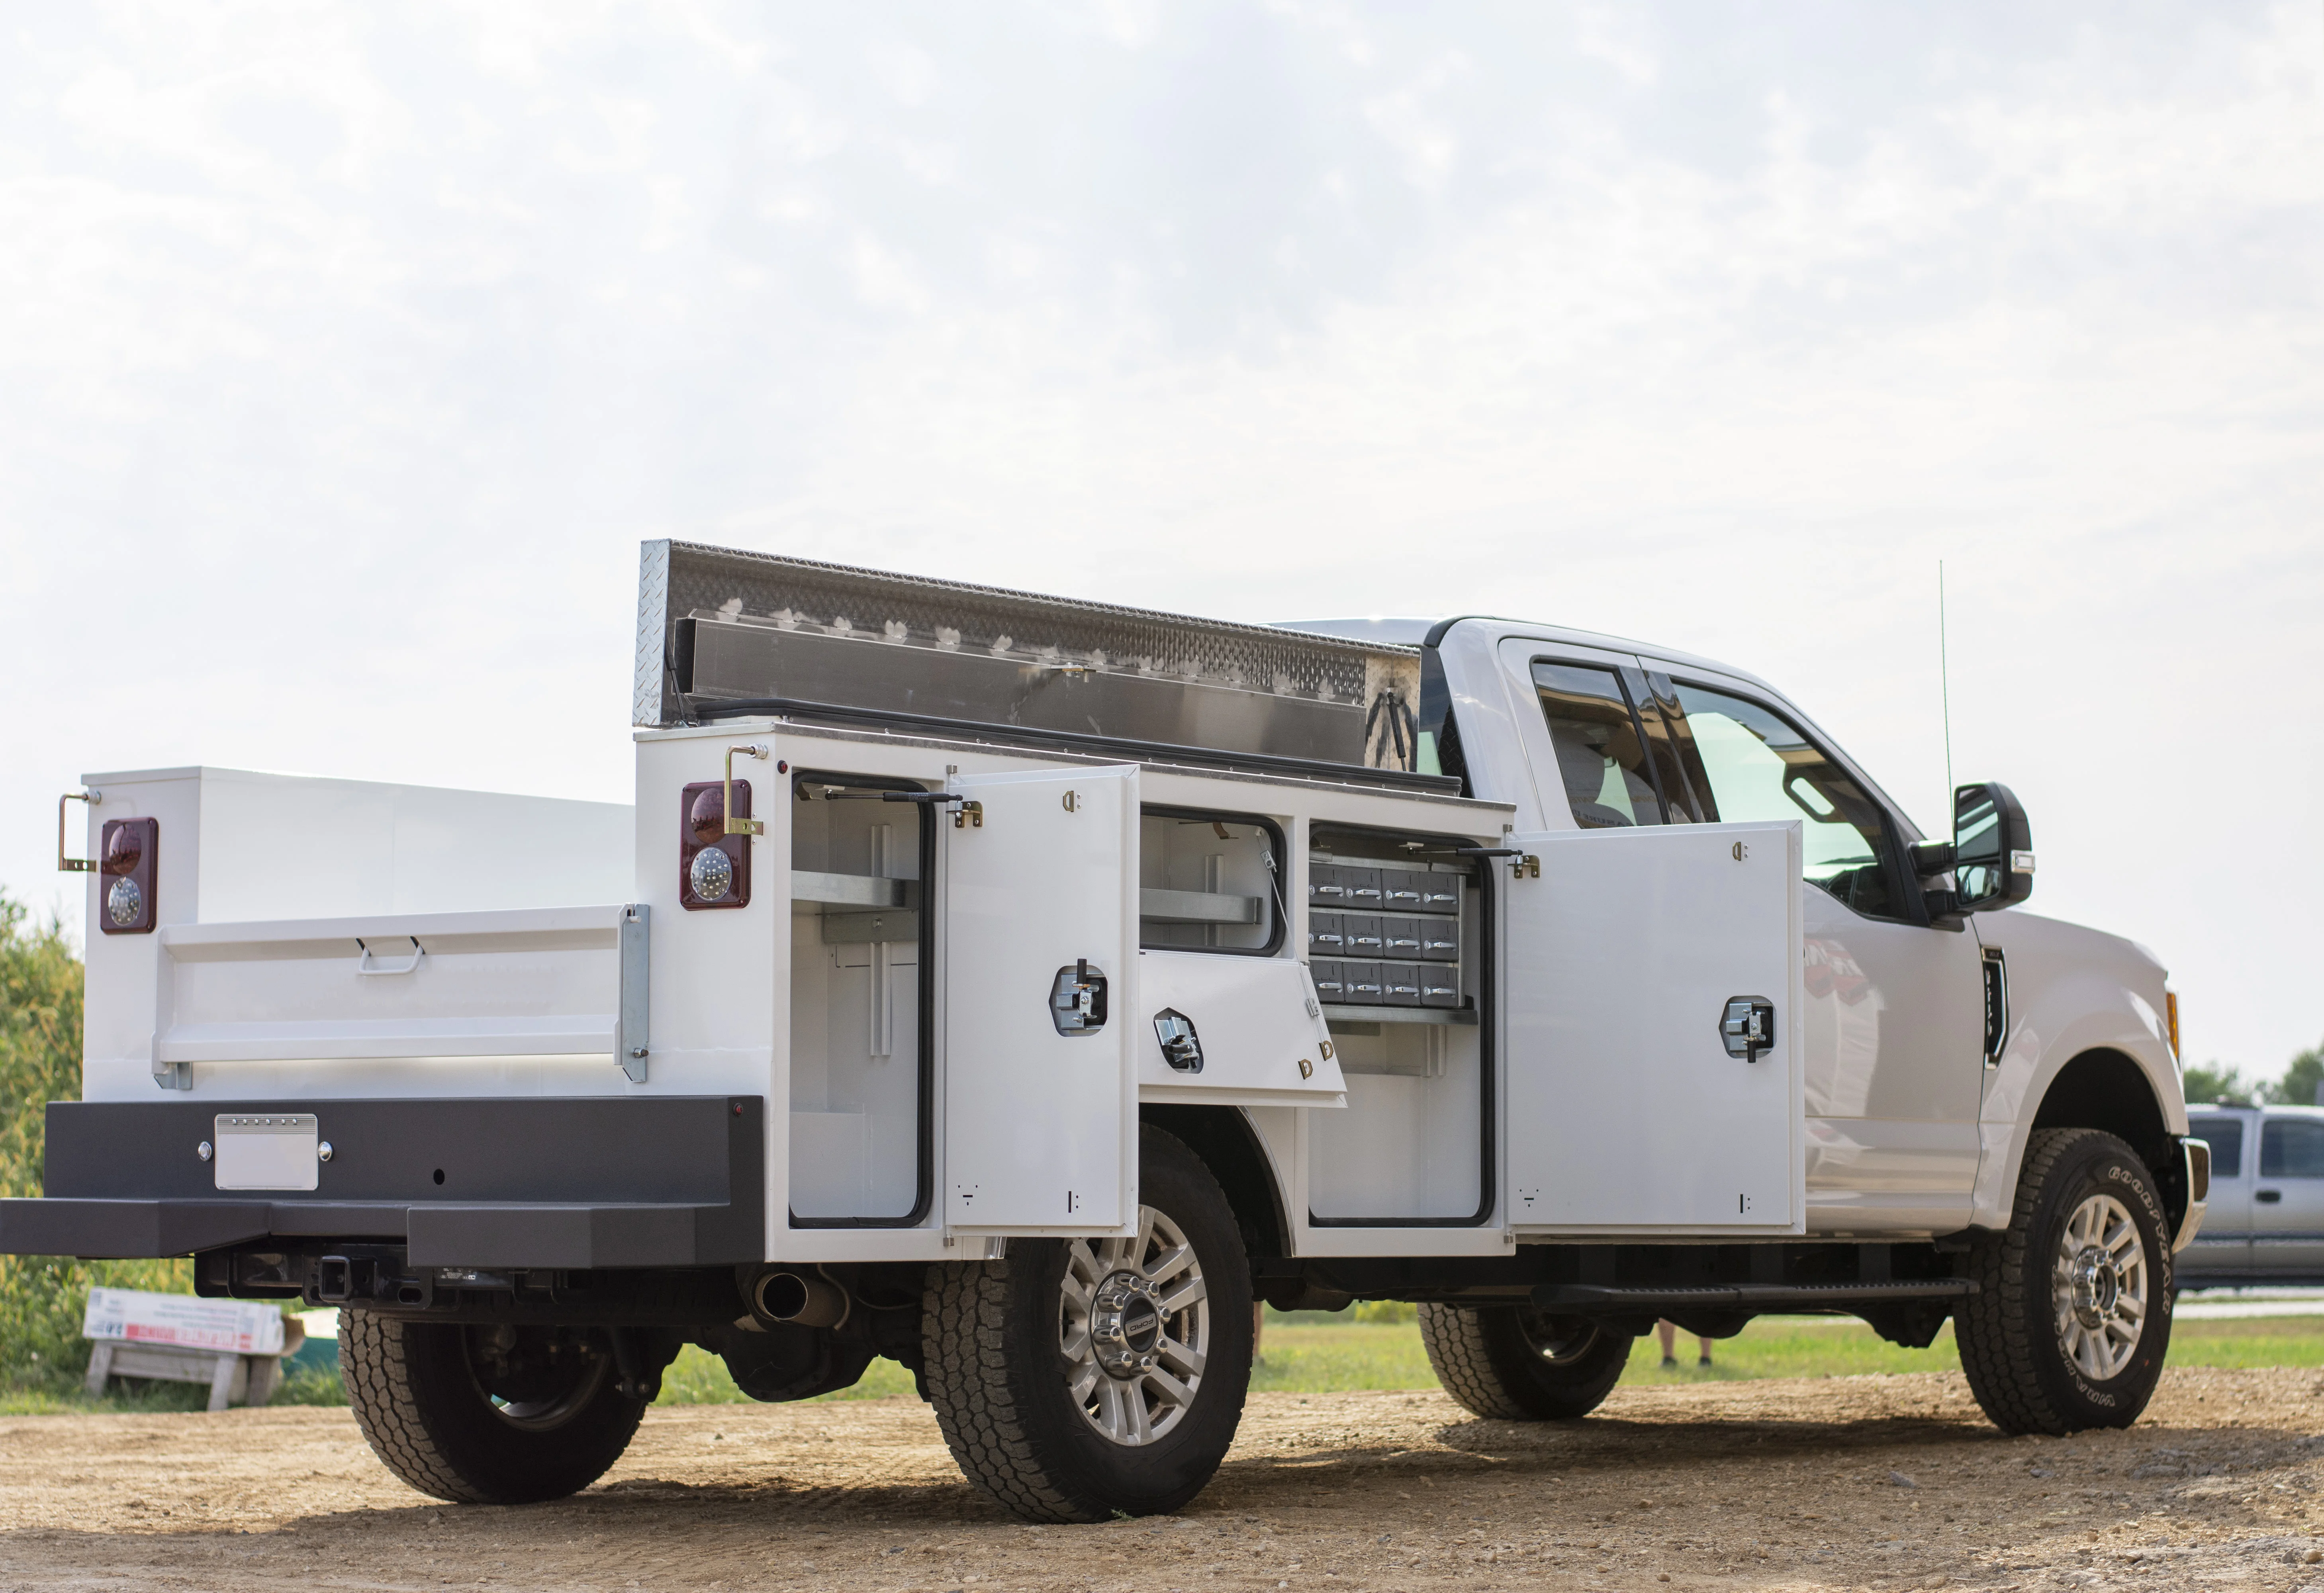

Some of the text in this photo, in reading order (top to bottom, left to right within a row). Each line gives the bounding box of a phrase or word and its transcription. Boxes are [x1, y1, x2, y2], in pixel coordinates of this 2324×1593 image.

[2109, 1166, 2171, 1315] GOODYEAR
[1130, 1318, 1153, 1331] FORD
[2052, 1264, 2116, 1407] WRANGLER
